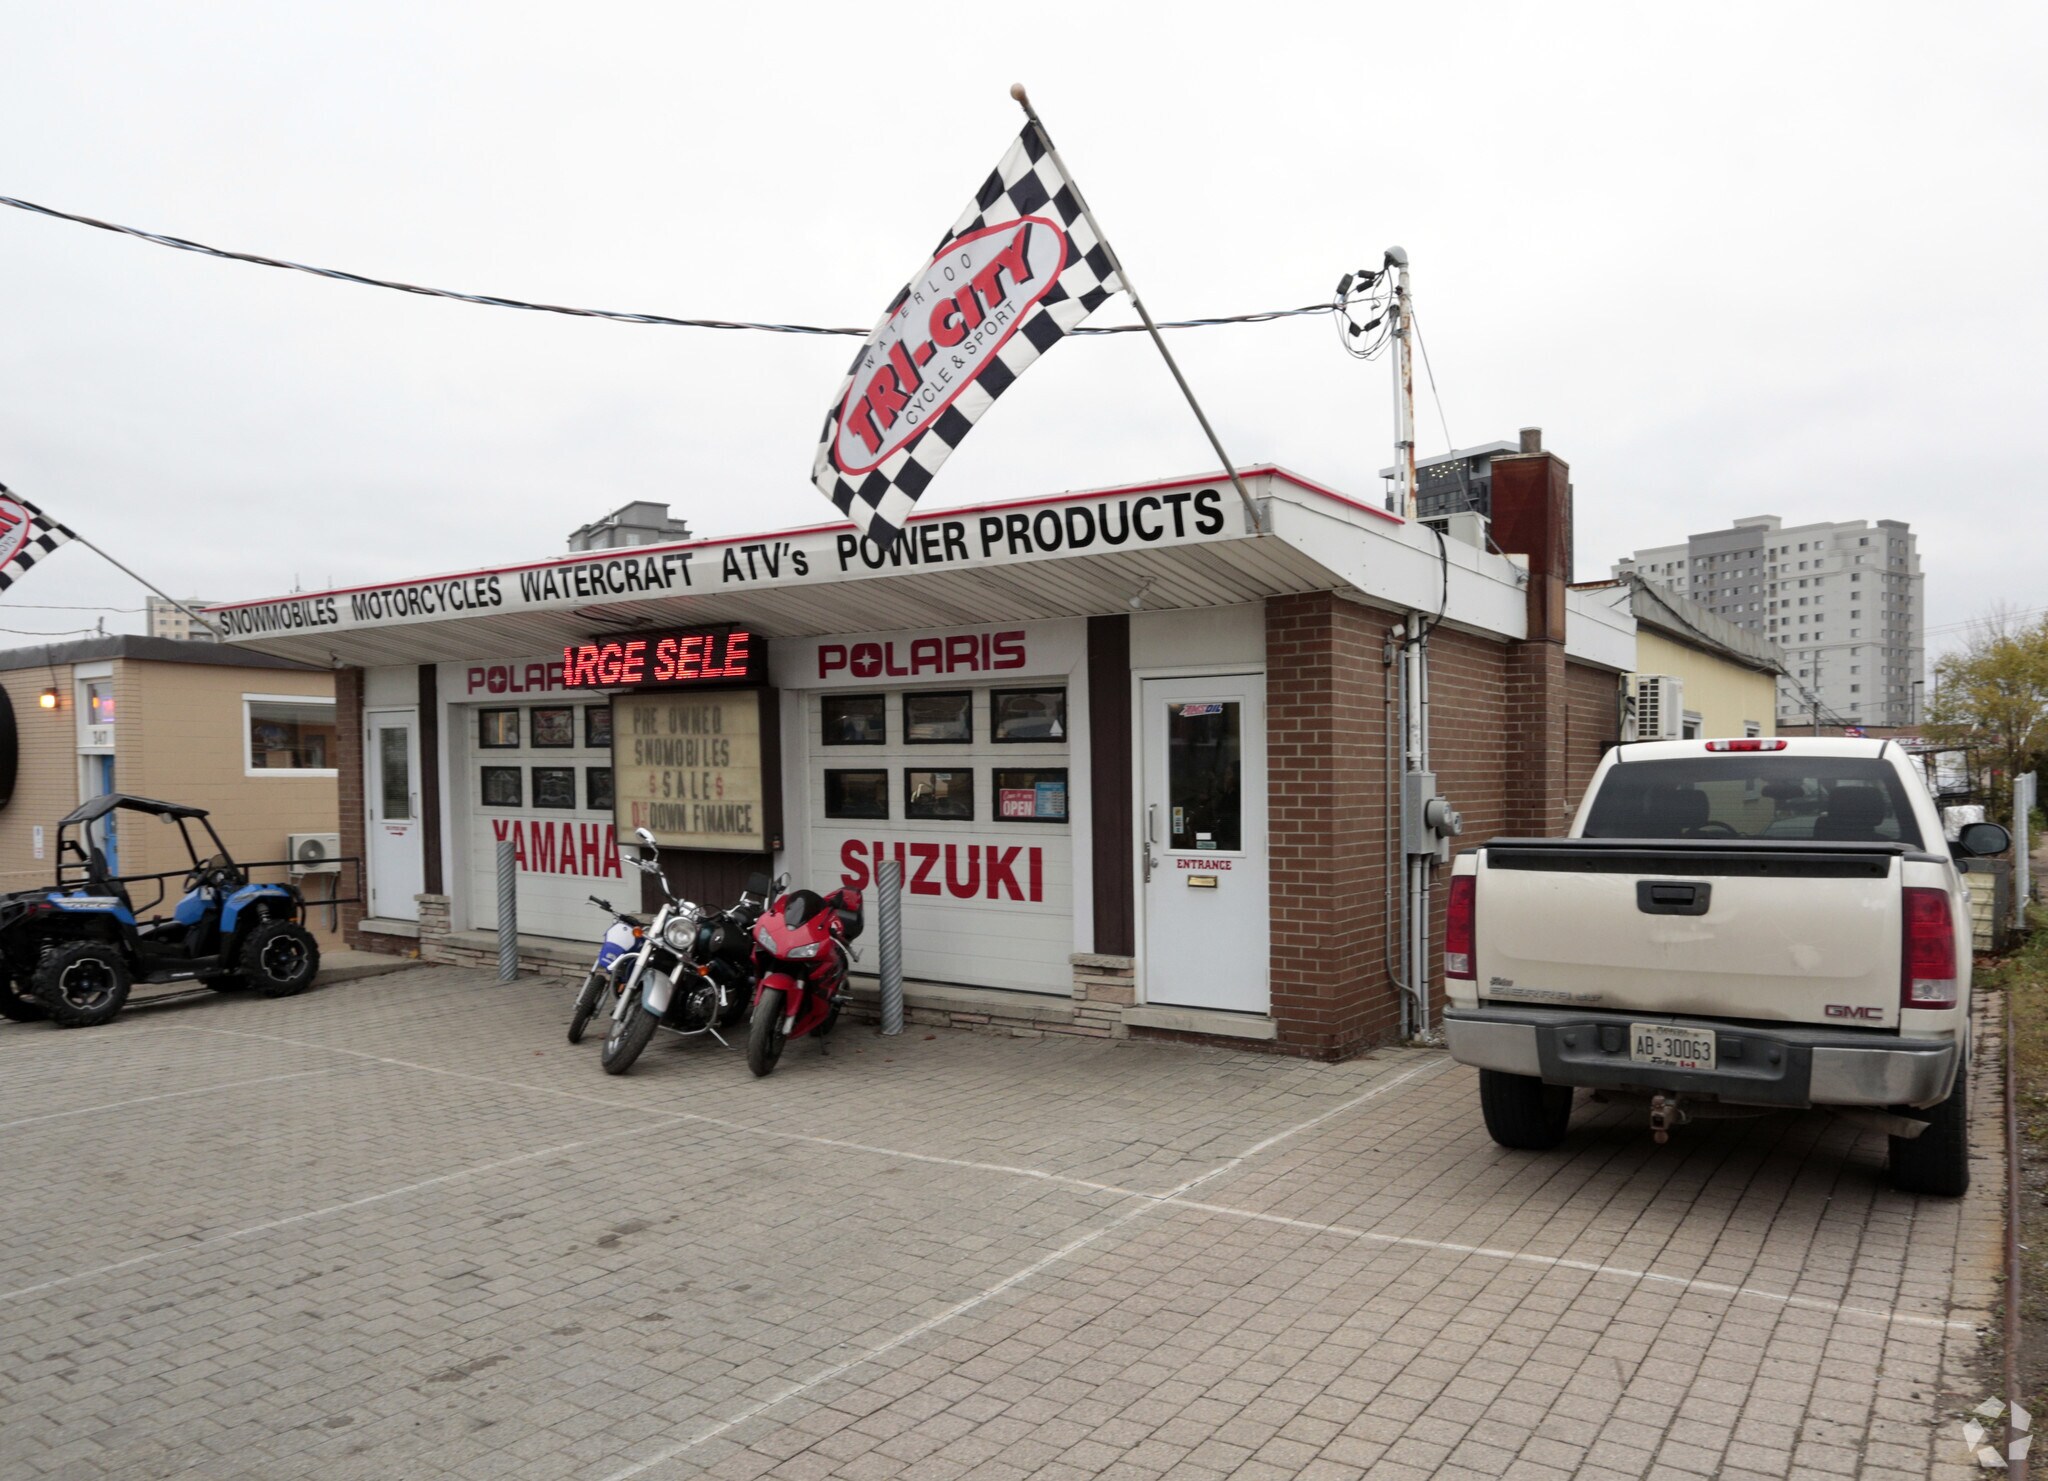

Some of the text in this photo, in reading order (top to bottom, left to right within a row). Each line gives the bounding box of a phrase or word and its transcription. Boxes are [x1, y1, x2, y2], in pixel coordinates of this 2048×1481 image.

[864, 252, 973, 370] WATERLOO
[846, 222, 1035, 457] TRI-CITY
[904, 302, 1018, 426] CYCLE & SPORT
[219, 488, 1226, 636] SNOWMOBILES MOTORCYCLES WATERCRAFT ATV's POWER PRODUCTS
[653, 632, 750, 681] SELE
[818, 631, 1026, 680] POLARIS
[467, 661, 566, 696] POLAR
[633, 705, 722, 735] PRE OWNED
[1181, 704, 1222, 715] AMSOIL
[634, 738, 730, 768] SNOMOBILES
[662, 770, 710, 800] SALE
[650, 802, 686, 831] DOWN
[693, 805, 753, 833] FINANCE
[1002, 801, 1033, 816] OPEN
[492, 819, 623, 878] YAMAHA
[1176, 859, 1232, 870] ENTRANCE
[840, 839, 1043, 902] SUZUKI
[1825, 1004, 1883, 1020] GMC
